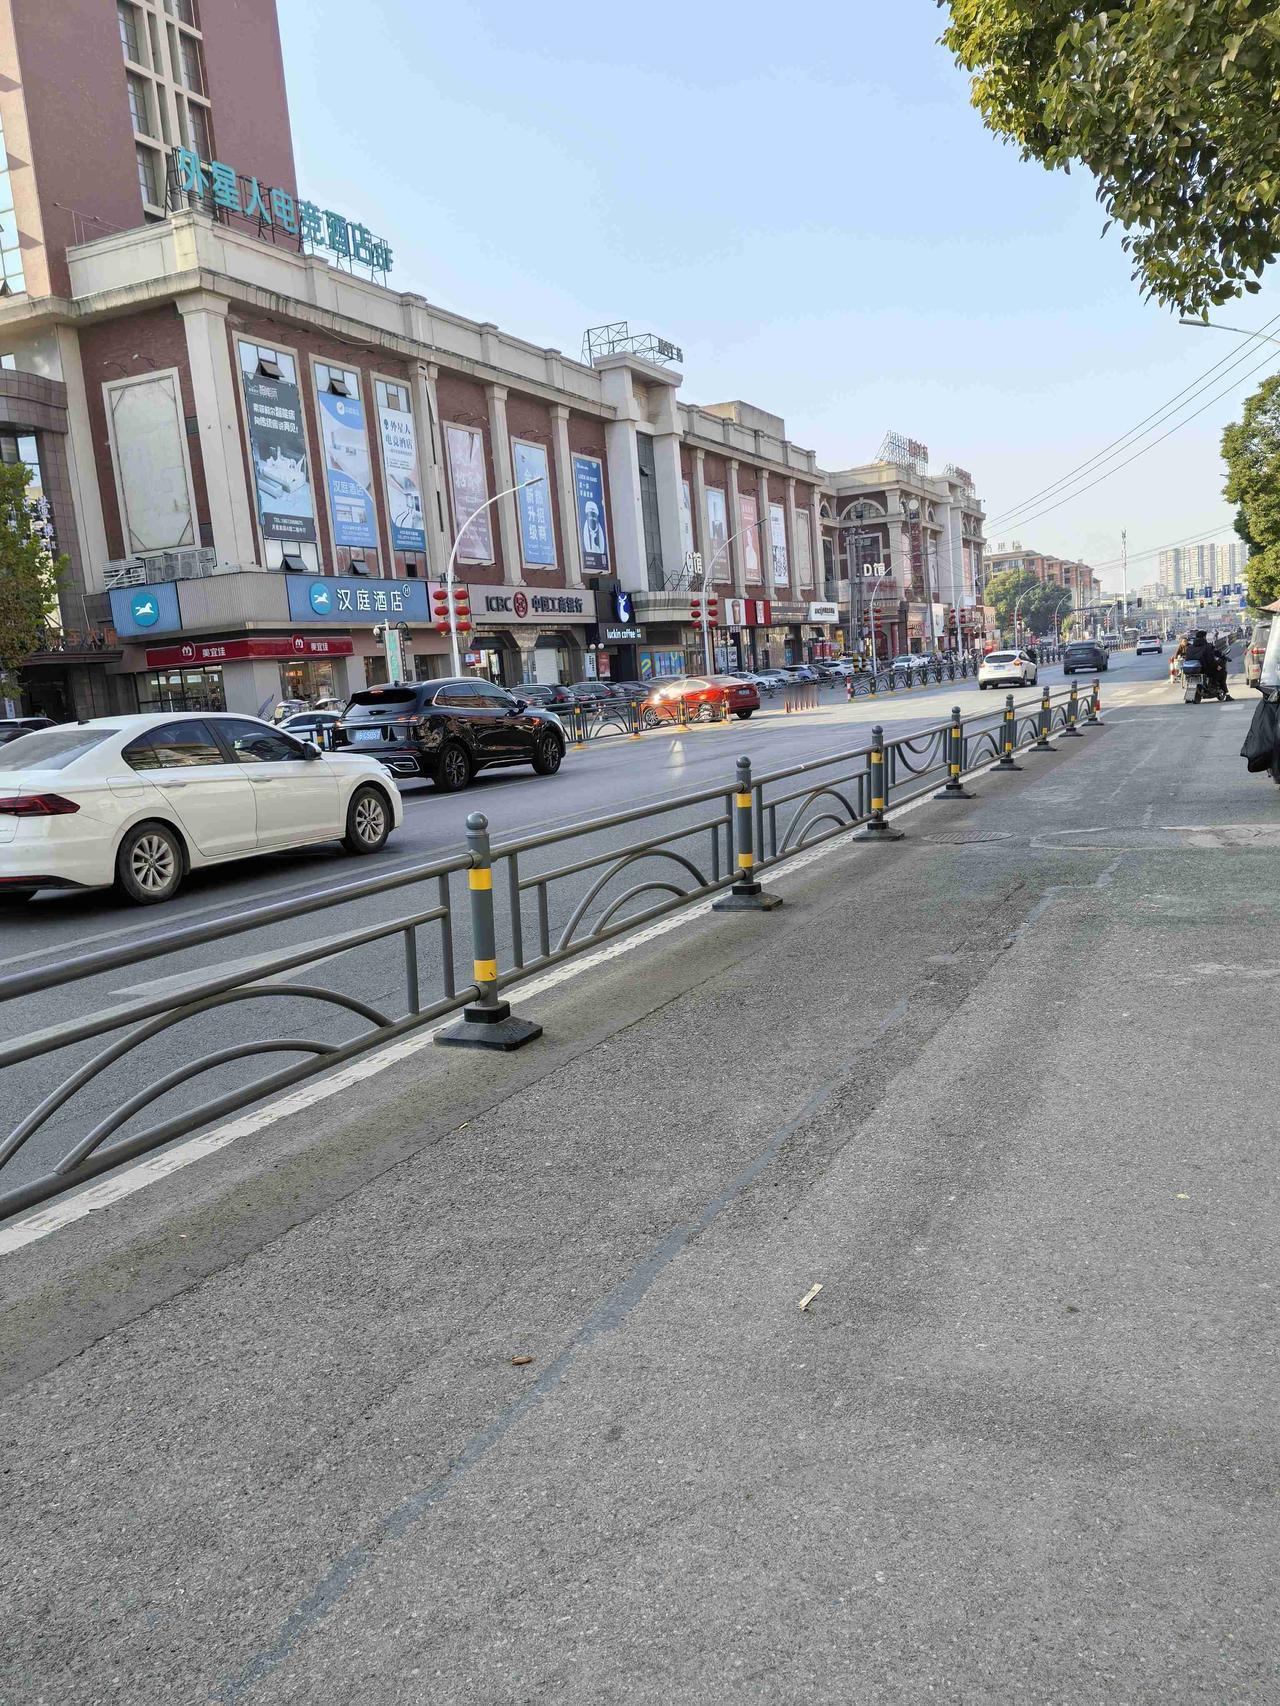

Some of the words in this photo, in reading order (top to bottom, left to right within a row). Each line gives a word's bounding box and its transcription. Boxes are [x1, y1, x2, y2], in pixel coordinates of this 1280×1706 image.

[863, 562, 886, 577] D馆
[336, 588, 403, 612] 汉庭酒店
[485, 595, 512, 613] ICBC
[531, 595, 583, 613] 中国工商银行
[606, 628, 621, 639] luckin
[621, 627, 636, 639] coffee
[202, 646, 226, 658] 美宜佳
[310, 642, 329, 652] 美宜佳
